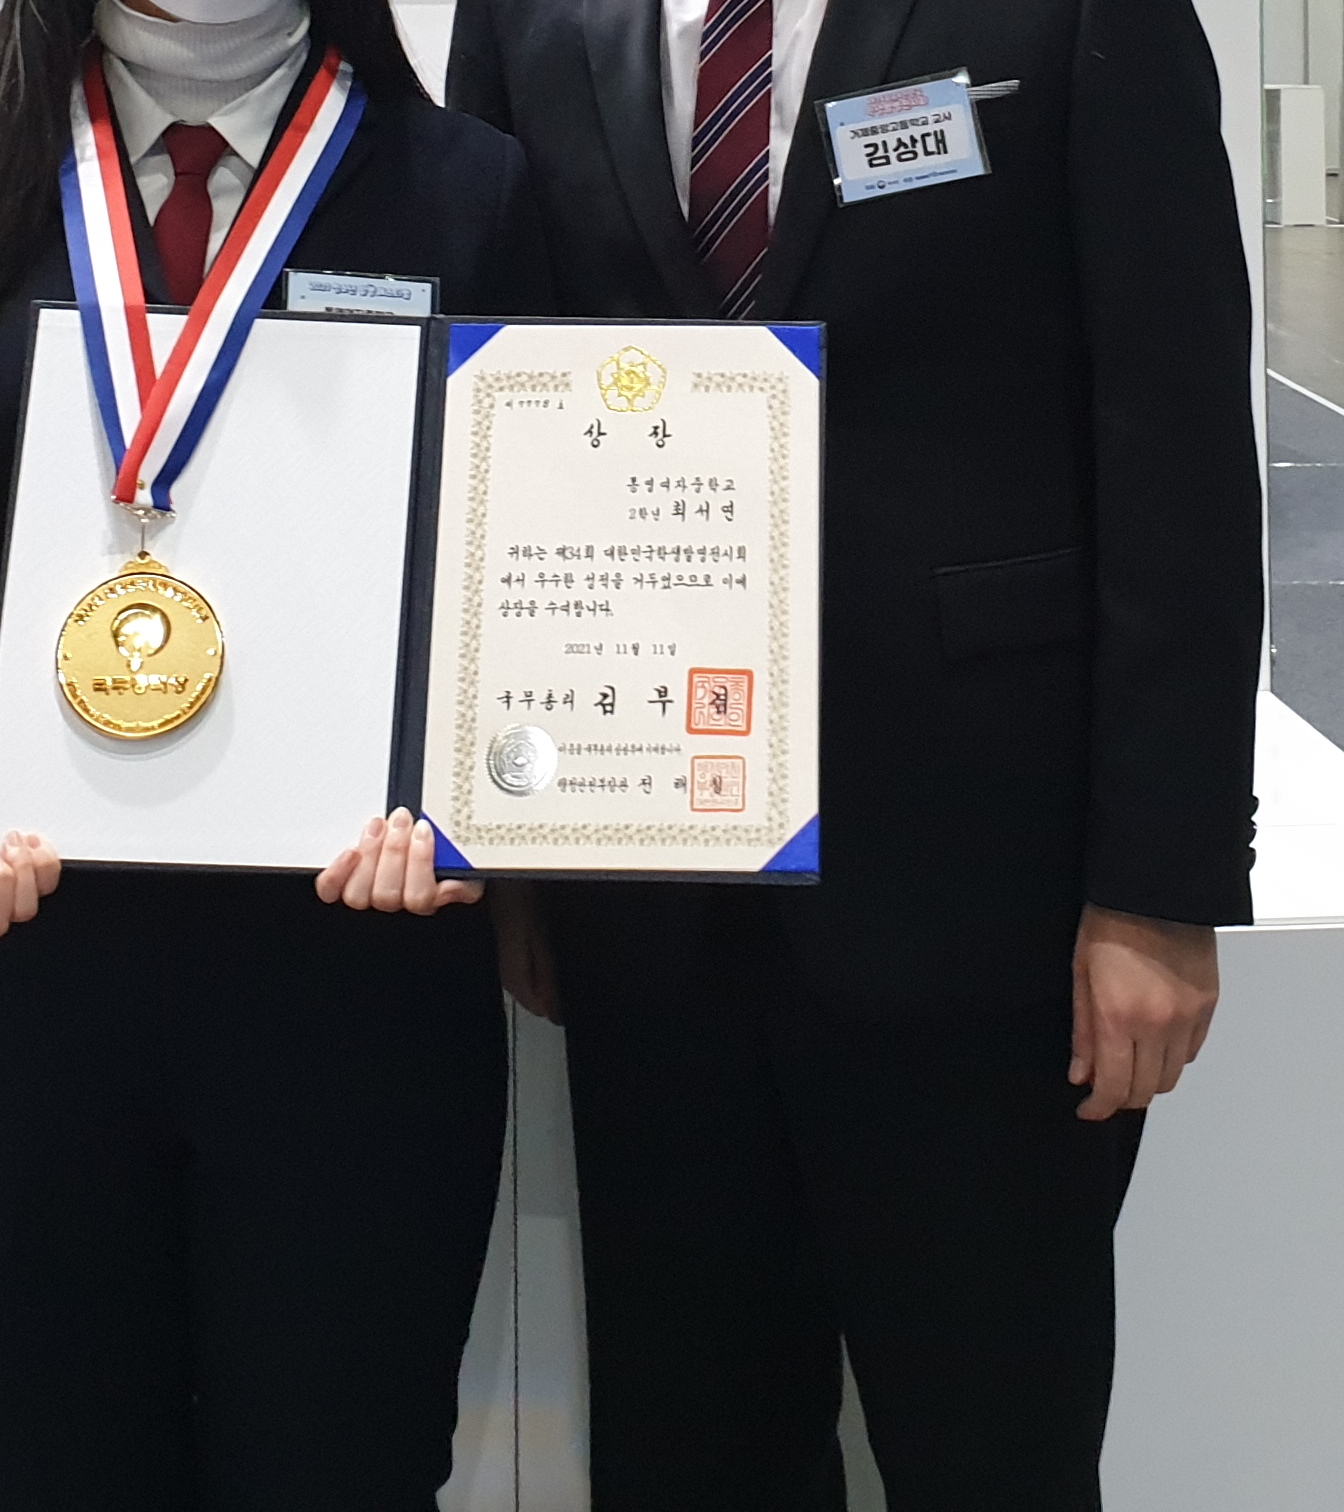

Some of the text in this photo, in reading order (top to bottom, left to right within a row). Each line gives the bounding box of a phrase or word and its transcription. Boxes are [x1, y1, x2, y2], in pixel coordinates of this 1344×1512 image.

[863, 129, 949, 168] 김상대
[564, 642, 677, 656] 2021년 11월 11일
[496, 689, 576, 712] 국무총리
